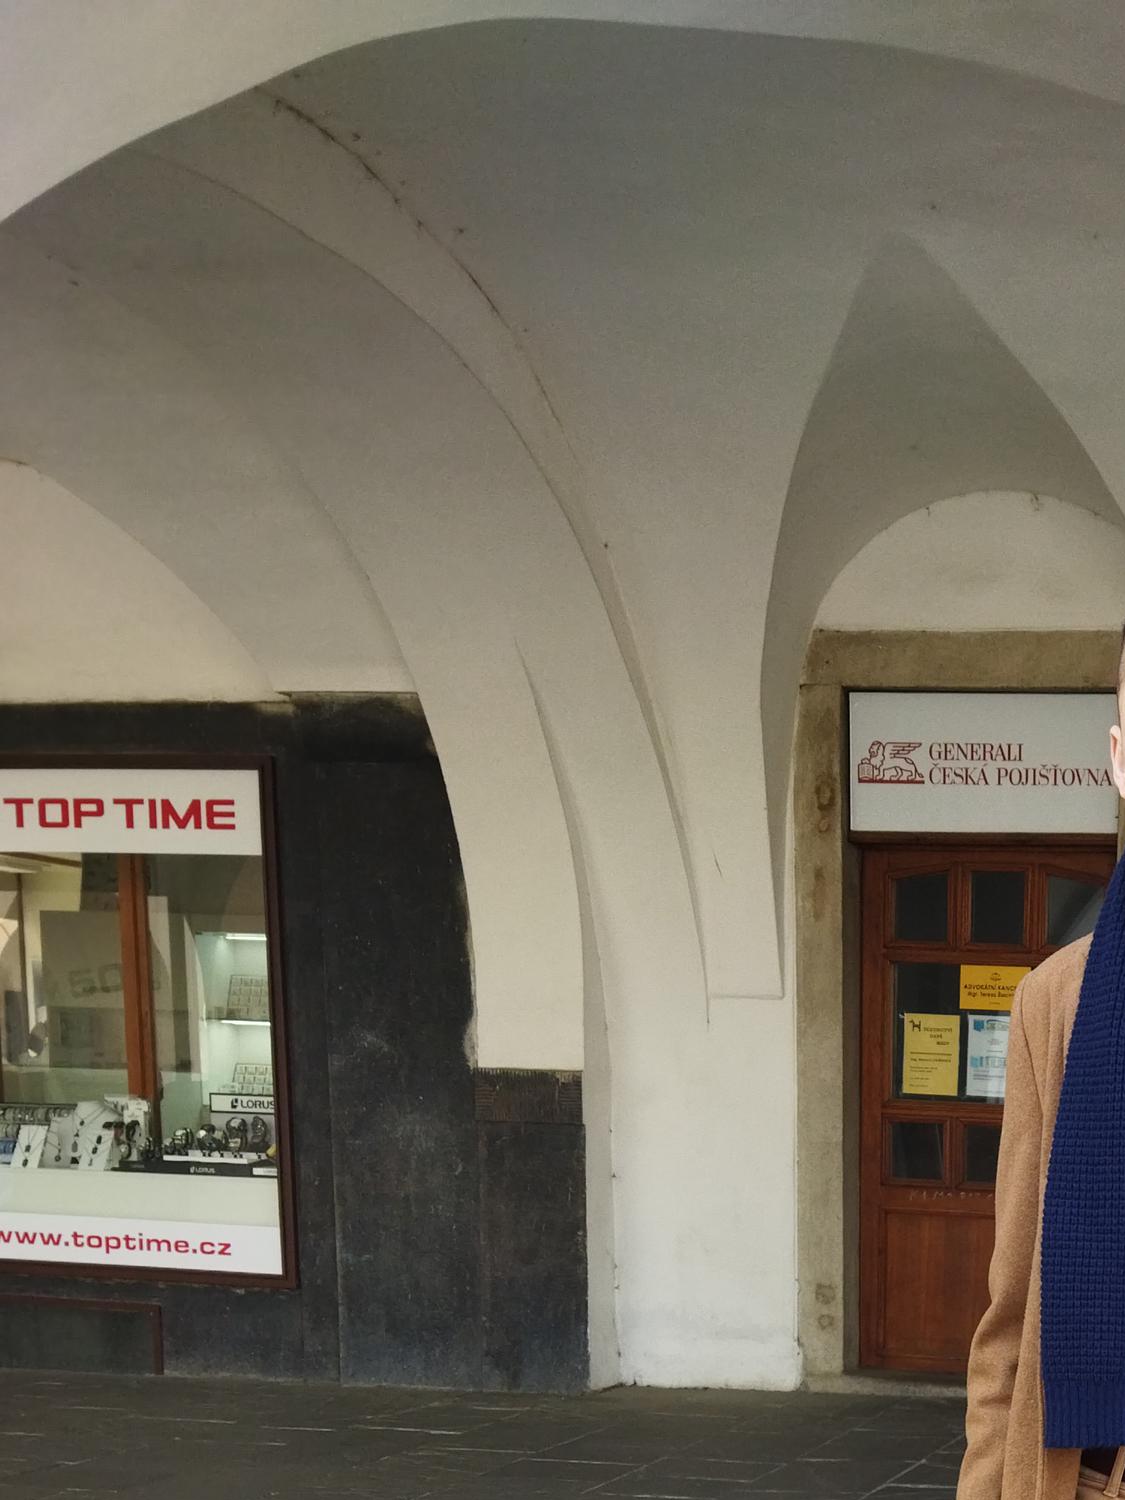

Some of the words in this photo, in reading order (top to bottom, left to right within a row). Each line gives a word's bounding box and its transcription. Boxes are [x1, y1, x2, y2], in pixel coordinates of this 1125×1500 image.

[928, 742, 1024, 762] GENERALI
[928, 763, 989, 786] ČESKÁ
[996, 764, 1114, 787] POJIŠŤOVNA
[3, 798, 105, 829] TOP
[113, 798, 236, 830] TIME
[240, 1099, 275, 1110] LORUS
[0, 1229, 232, 1256] www.toptime.cz
